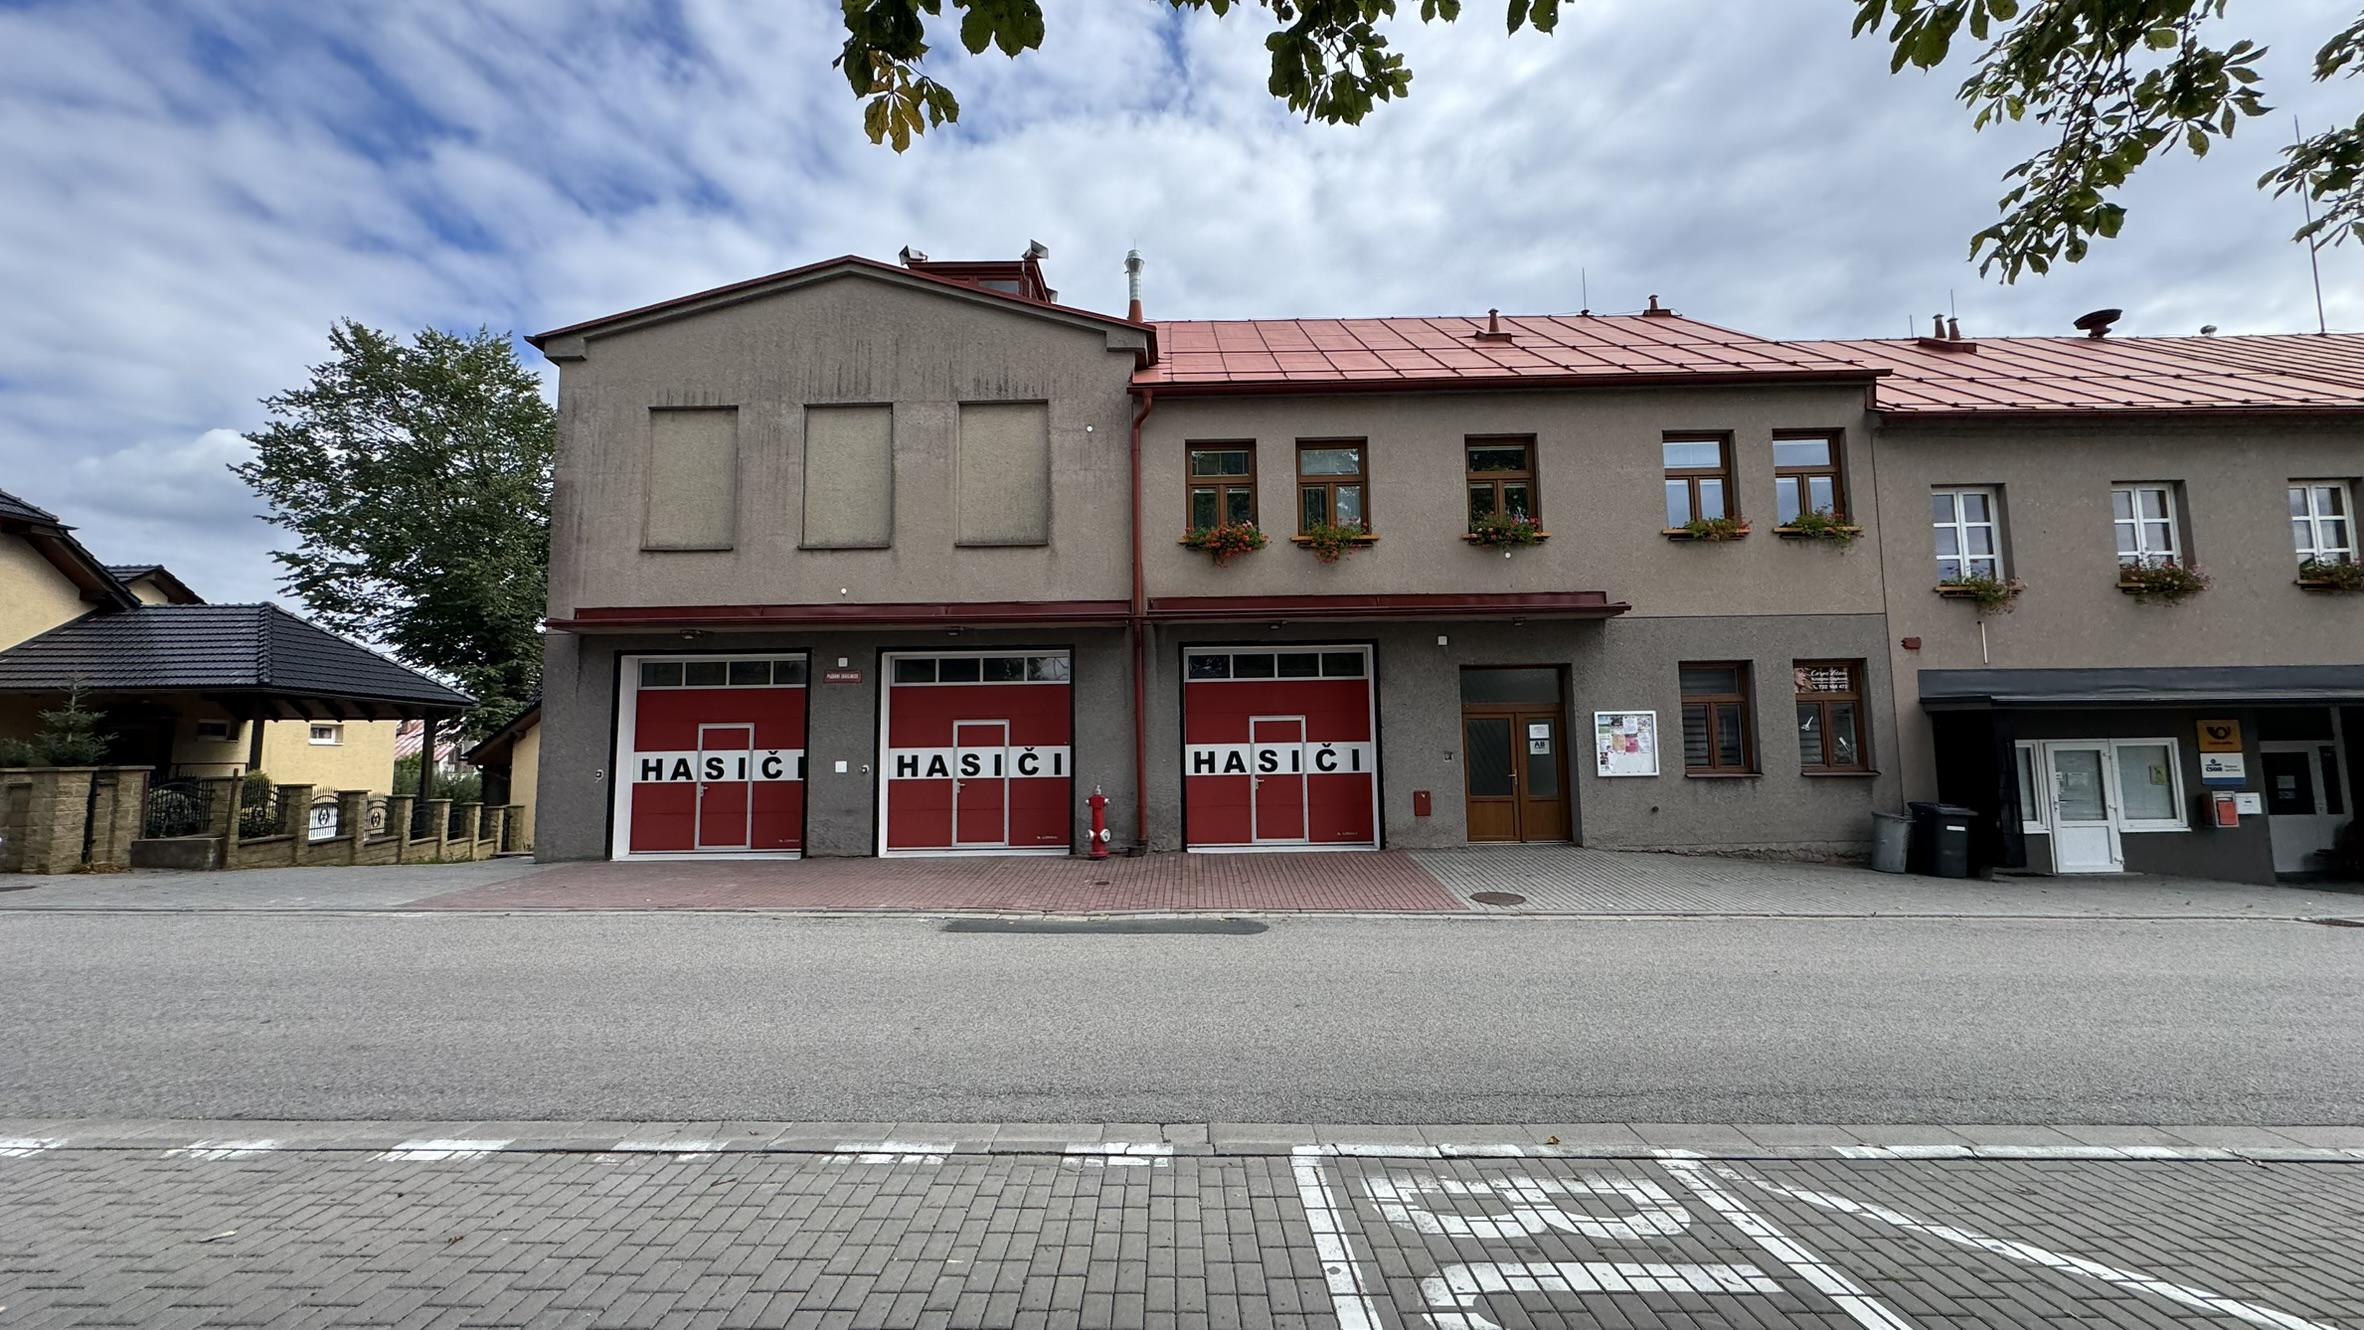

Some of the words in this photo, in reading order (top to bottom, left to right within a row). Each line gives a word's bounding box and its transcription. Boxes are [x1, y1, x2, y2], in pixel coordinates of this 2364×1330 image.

[641, 750, 804, 781] HASIČI
[897, 747, 1062, 777] HASIČI
[1193, 743, 1360, 773] HASIČI
